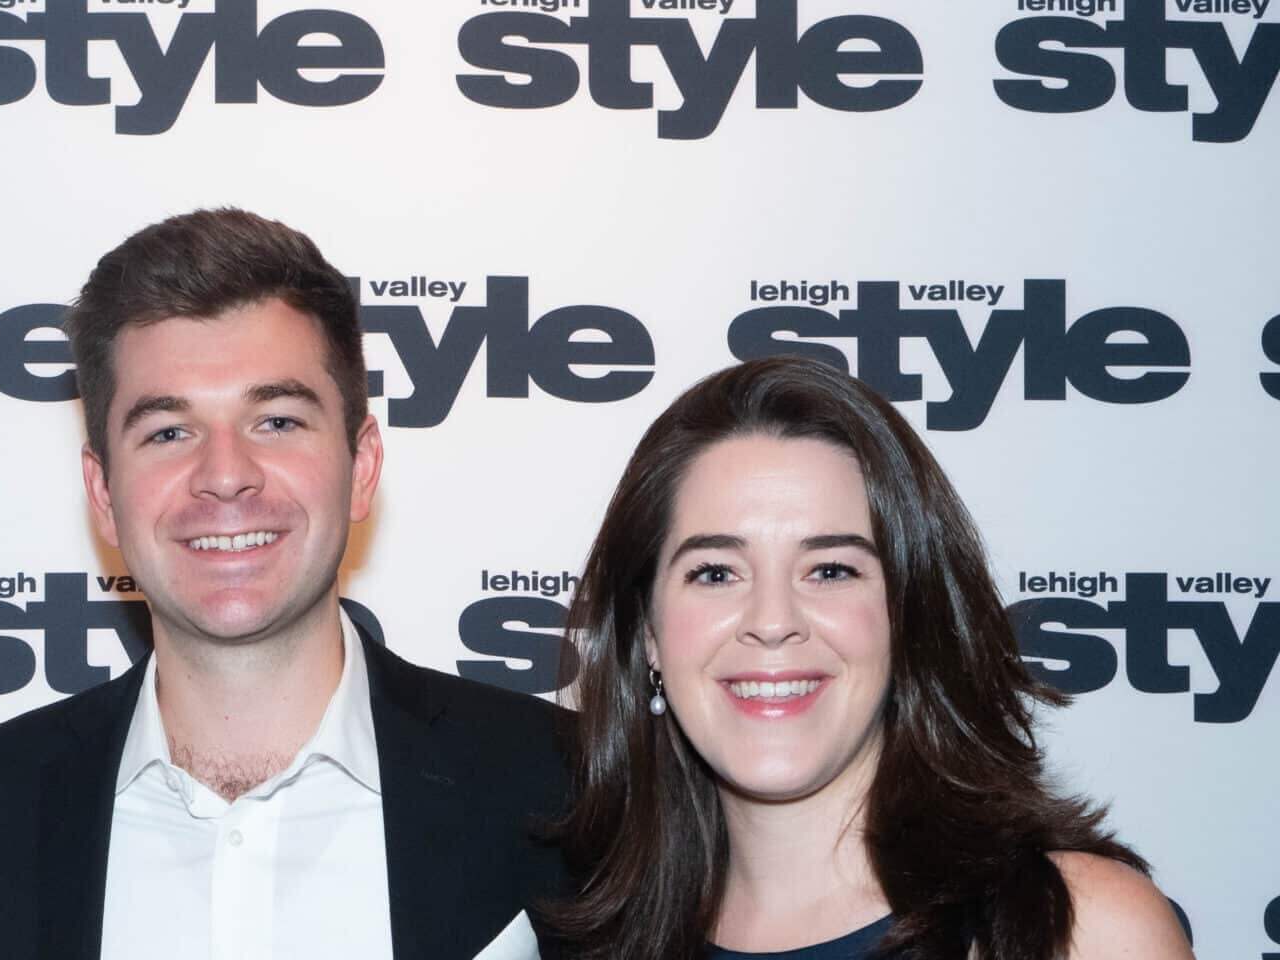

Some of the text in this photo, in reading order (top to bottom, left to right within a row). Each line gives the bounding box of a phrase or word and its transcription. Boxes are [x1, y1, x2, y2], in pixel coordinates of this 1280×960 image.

[455, 0, 924, 141] style
[992, 0, 1280, 144] sty
[344, 275, 656, 429] yle
[370, 276, 467, 302] valley
[750, 279, 1005, 306] lehigh valley
[1002, 572, 1280, 725] sty
[1019, 571, 1272, 599] lehigh valley
